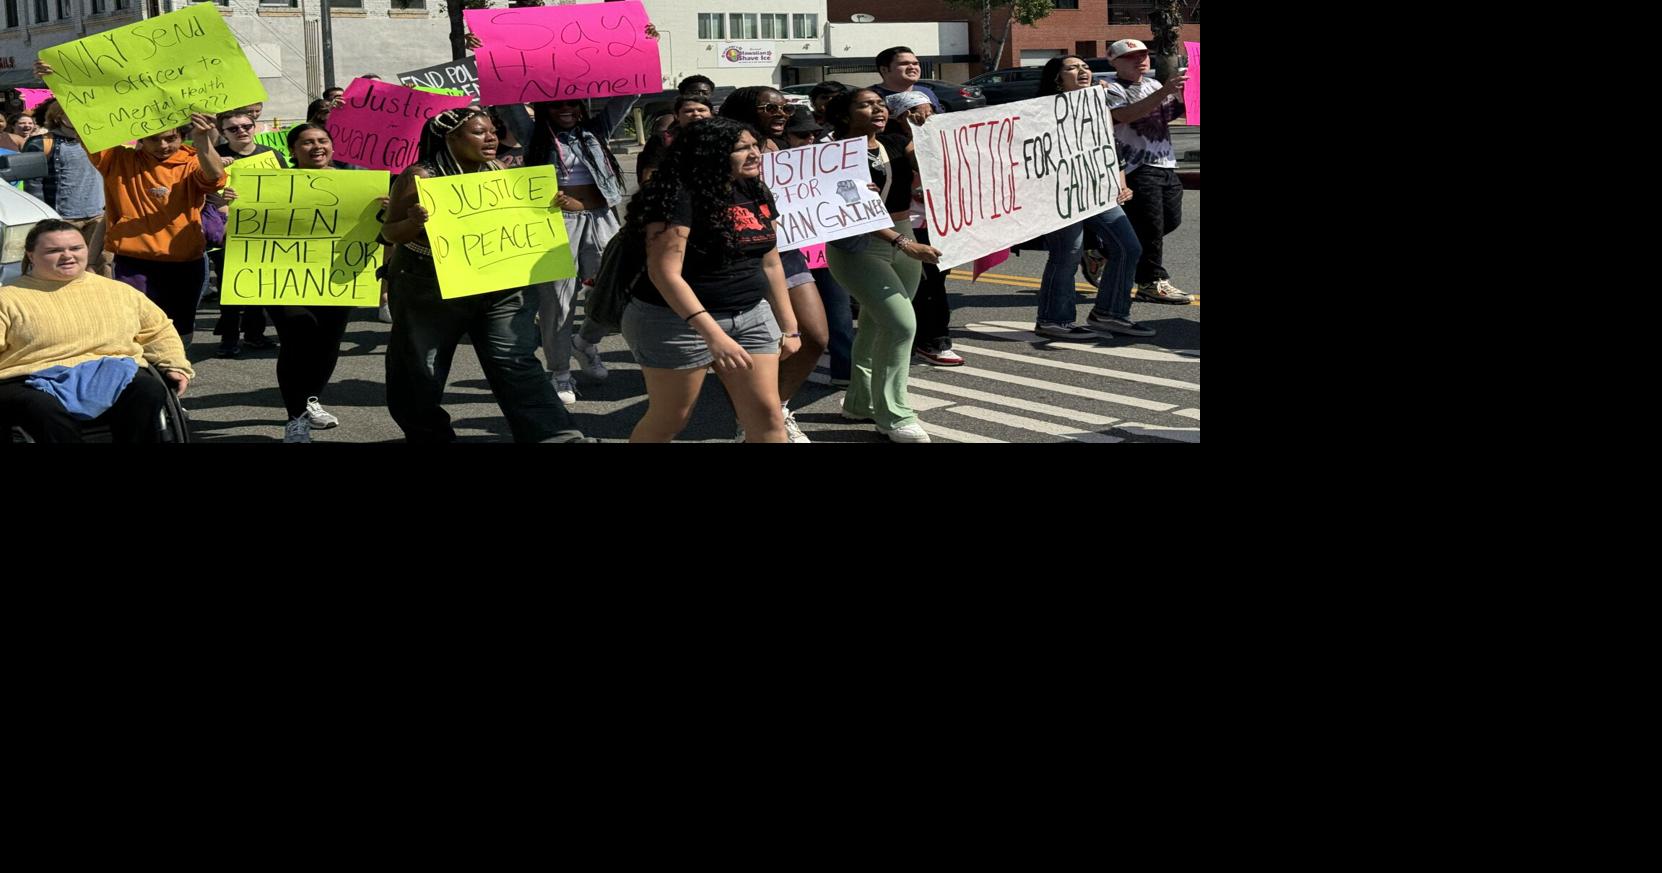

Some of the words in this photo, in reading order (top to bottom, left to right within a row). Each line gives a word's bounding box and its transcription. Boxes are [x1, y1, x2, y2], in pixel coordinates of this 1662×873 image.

[491, 12, 647, 57] Say
[199, 56, 222, 70] to
[445, 61, 479, 83] POL
[489, 46, 600, 82] His
[82, 122, 103, 136] a
[109, 97, 176, 127] Mental
[181, 77, 224, 99] Health
[351, 85, 447, 120] Justic
[1054, 88, 1112, 158] RYAN
[760, 138, 862, 190] USTICE
[925, 116, 1022, 237] JUSTICE
[1023, 132, 1057, 180] FOR
[1055, 144, 1121, 219] GAINER
[448, 175, 549, 215] JUSTICE
[781, 178, 822, 204] FOR
[235, 208, 338, 236] BEEN
[775, 207, 817, 244] YAN
[231, 239, 321, 263] TIME
[328, 239, 380, 268] FOR
[233, 268, 370, 300] CHANGE
